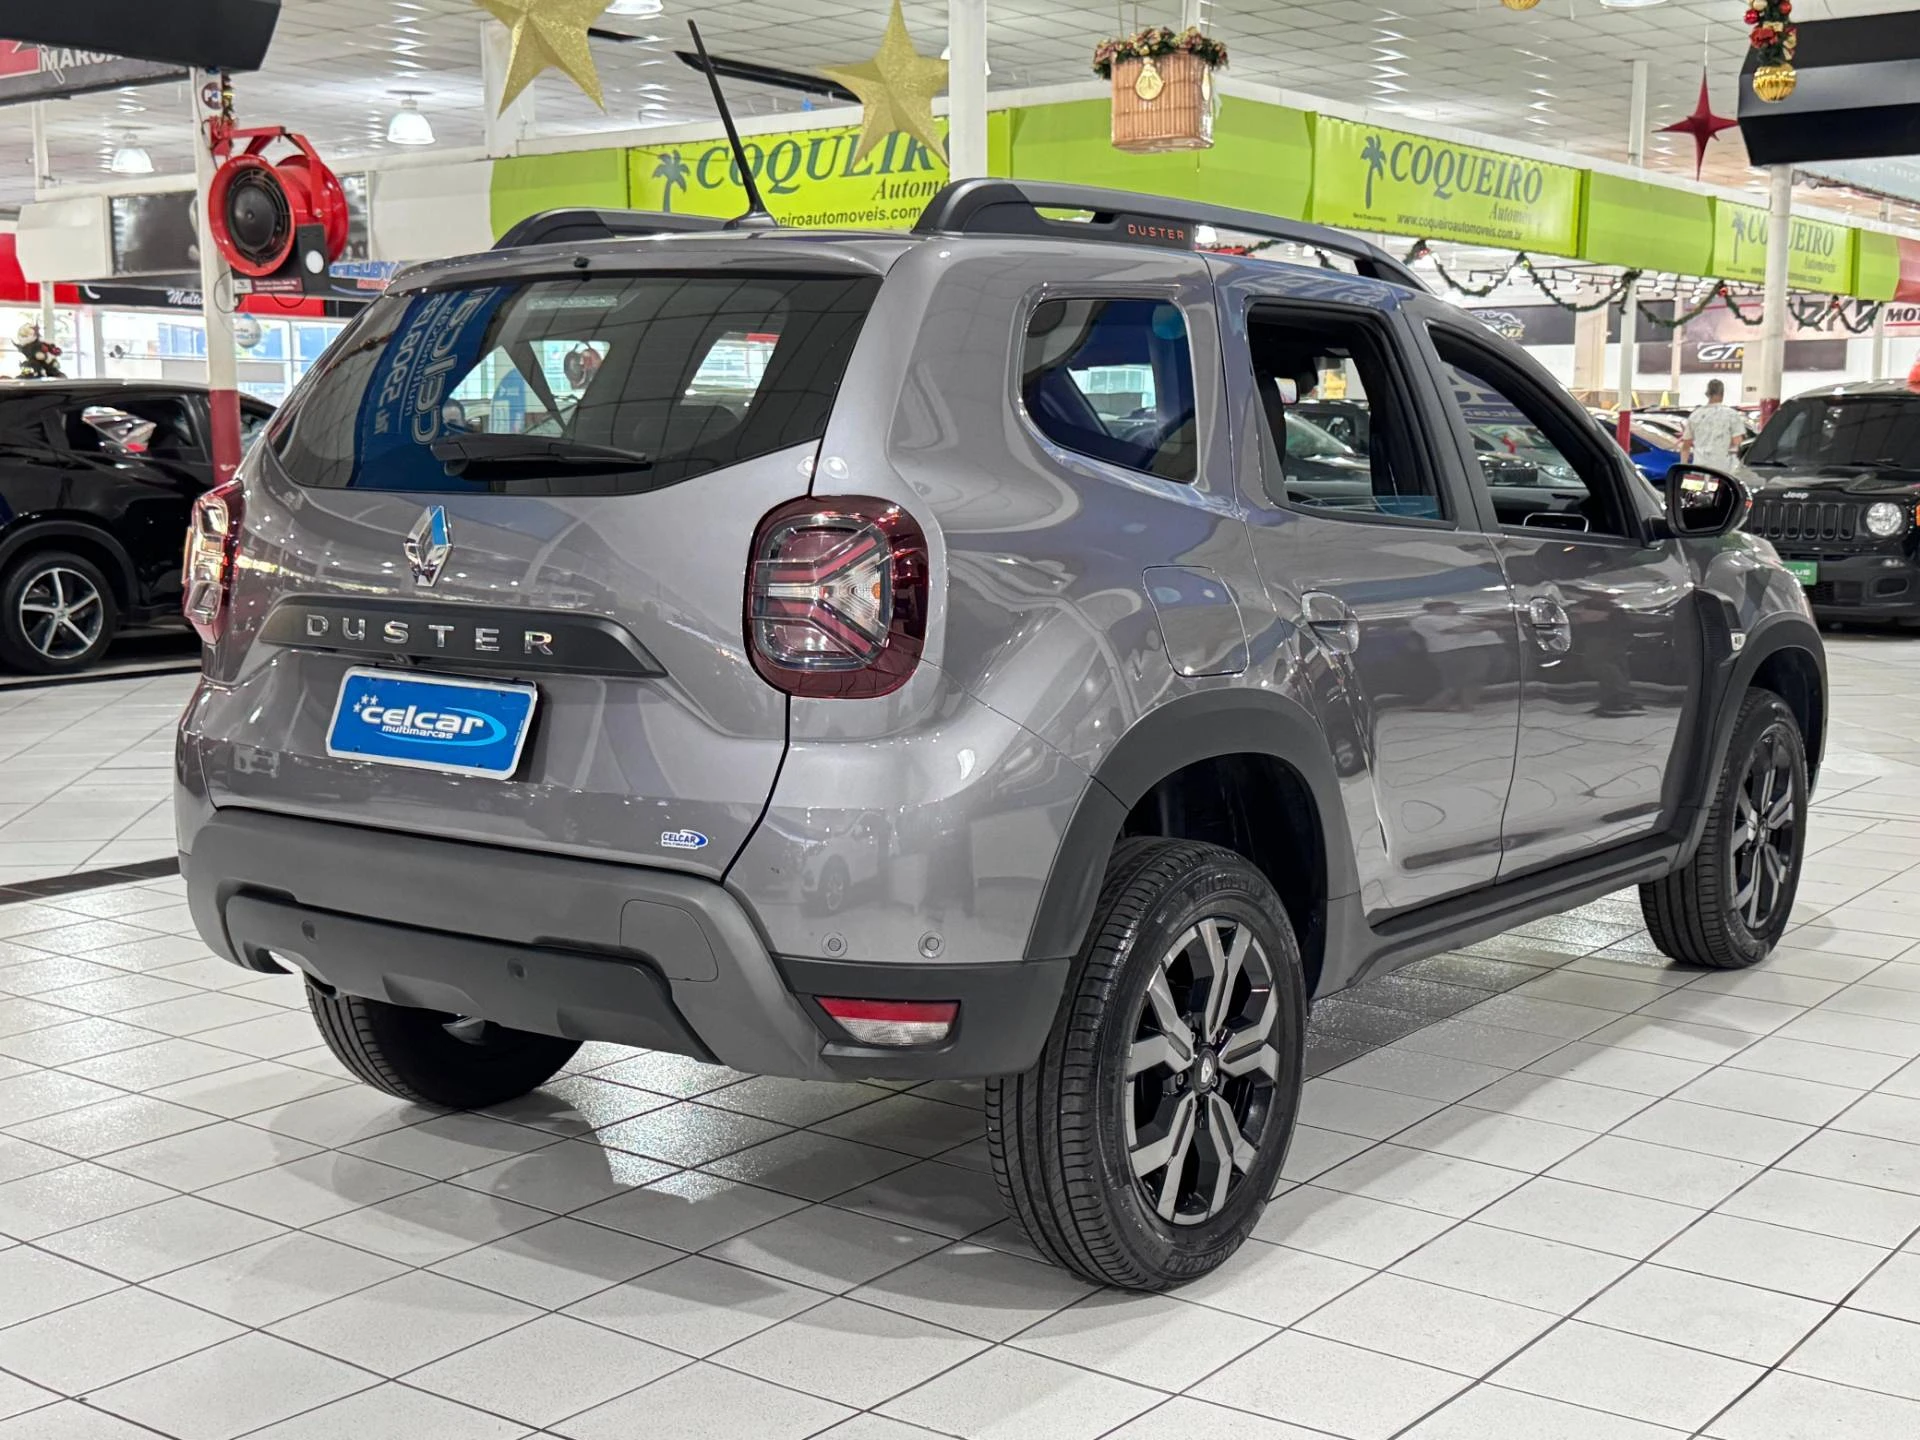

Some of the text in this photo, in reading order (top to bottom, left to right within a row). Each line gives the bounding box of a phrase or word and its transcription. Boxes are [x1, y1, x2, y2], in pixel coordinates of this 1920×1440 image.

[696, 130, 949, 194] COQUEIR
[1389, 140, 1543, 204] COQUEIRO
[871, 178, 949, 201] Autom
[776, 205, 921, 227] eiroautomoveis.com
[1127, 223, 1184, 240] DUSTER
[1782, 491, 1810, 500] Jeep
[306, 614, 555, 656] DUSTER
[361, 705, 485, 735] celcar
[382, 725, 454, 740] multimarcas
[662, 833, 697, 844] CELCAR
